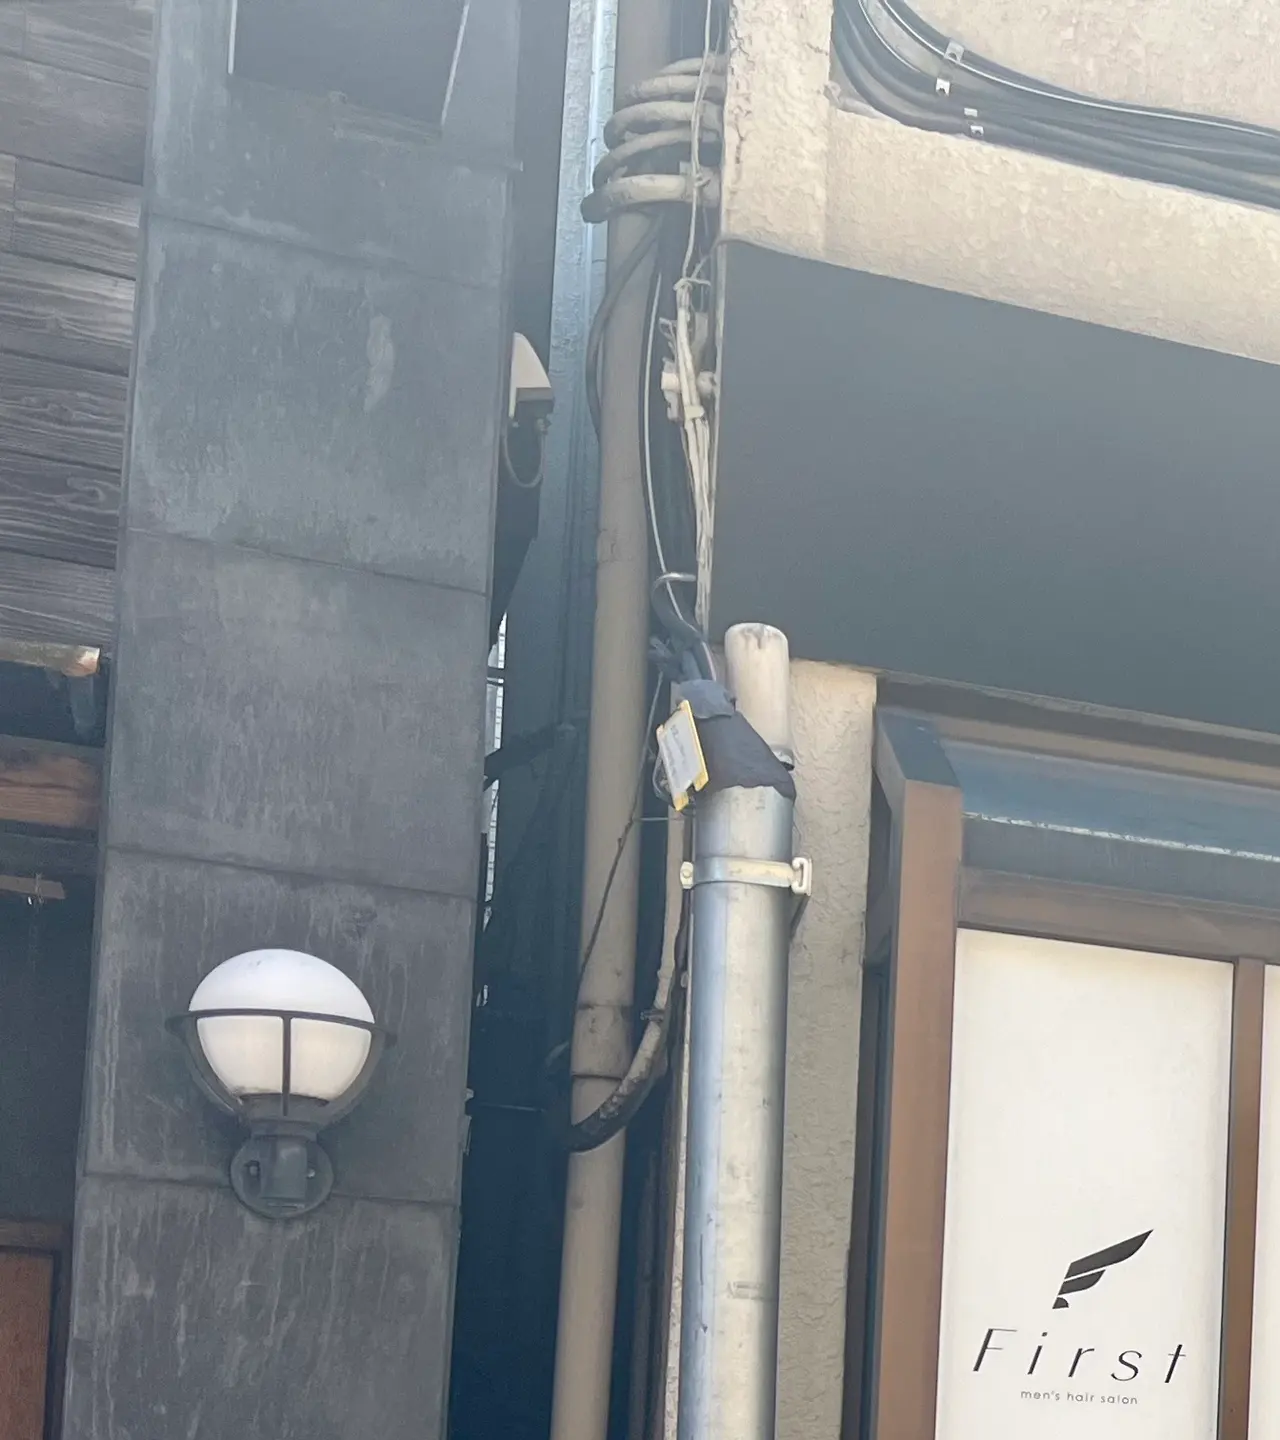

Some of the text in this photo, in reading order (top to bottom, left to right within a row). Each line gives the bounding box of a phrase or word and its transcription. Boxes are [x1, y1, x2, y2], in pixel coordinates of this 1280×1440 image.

[972, 1328, 1187, 1384] First
[1020, 1389, 1138, 1405] men's hair salon
